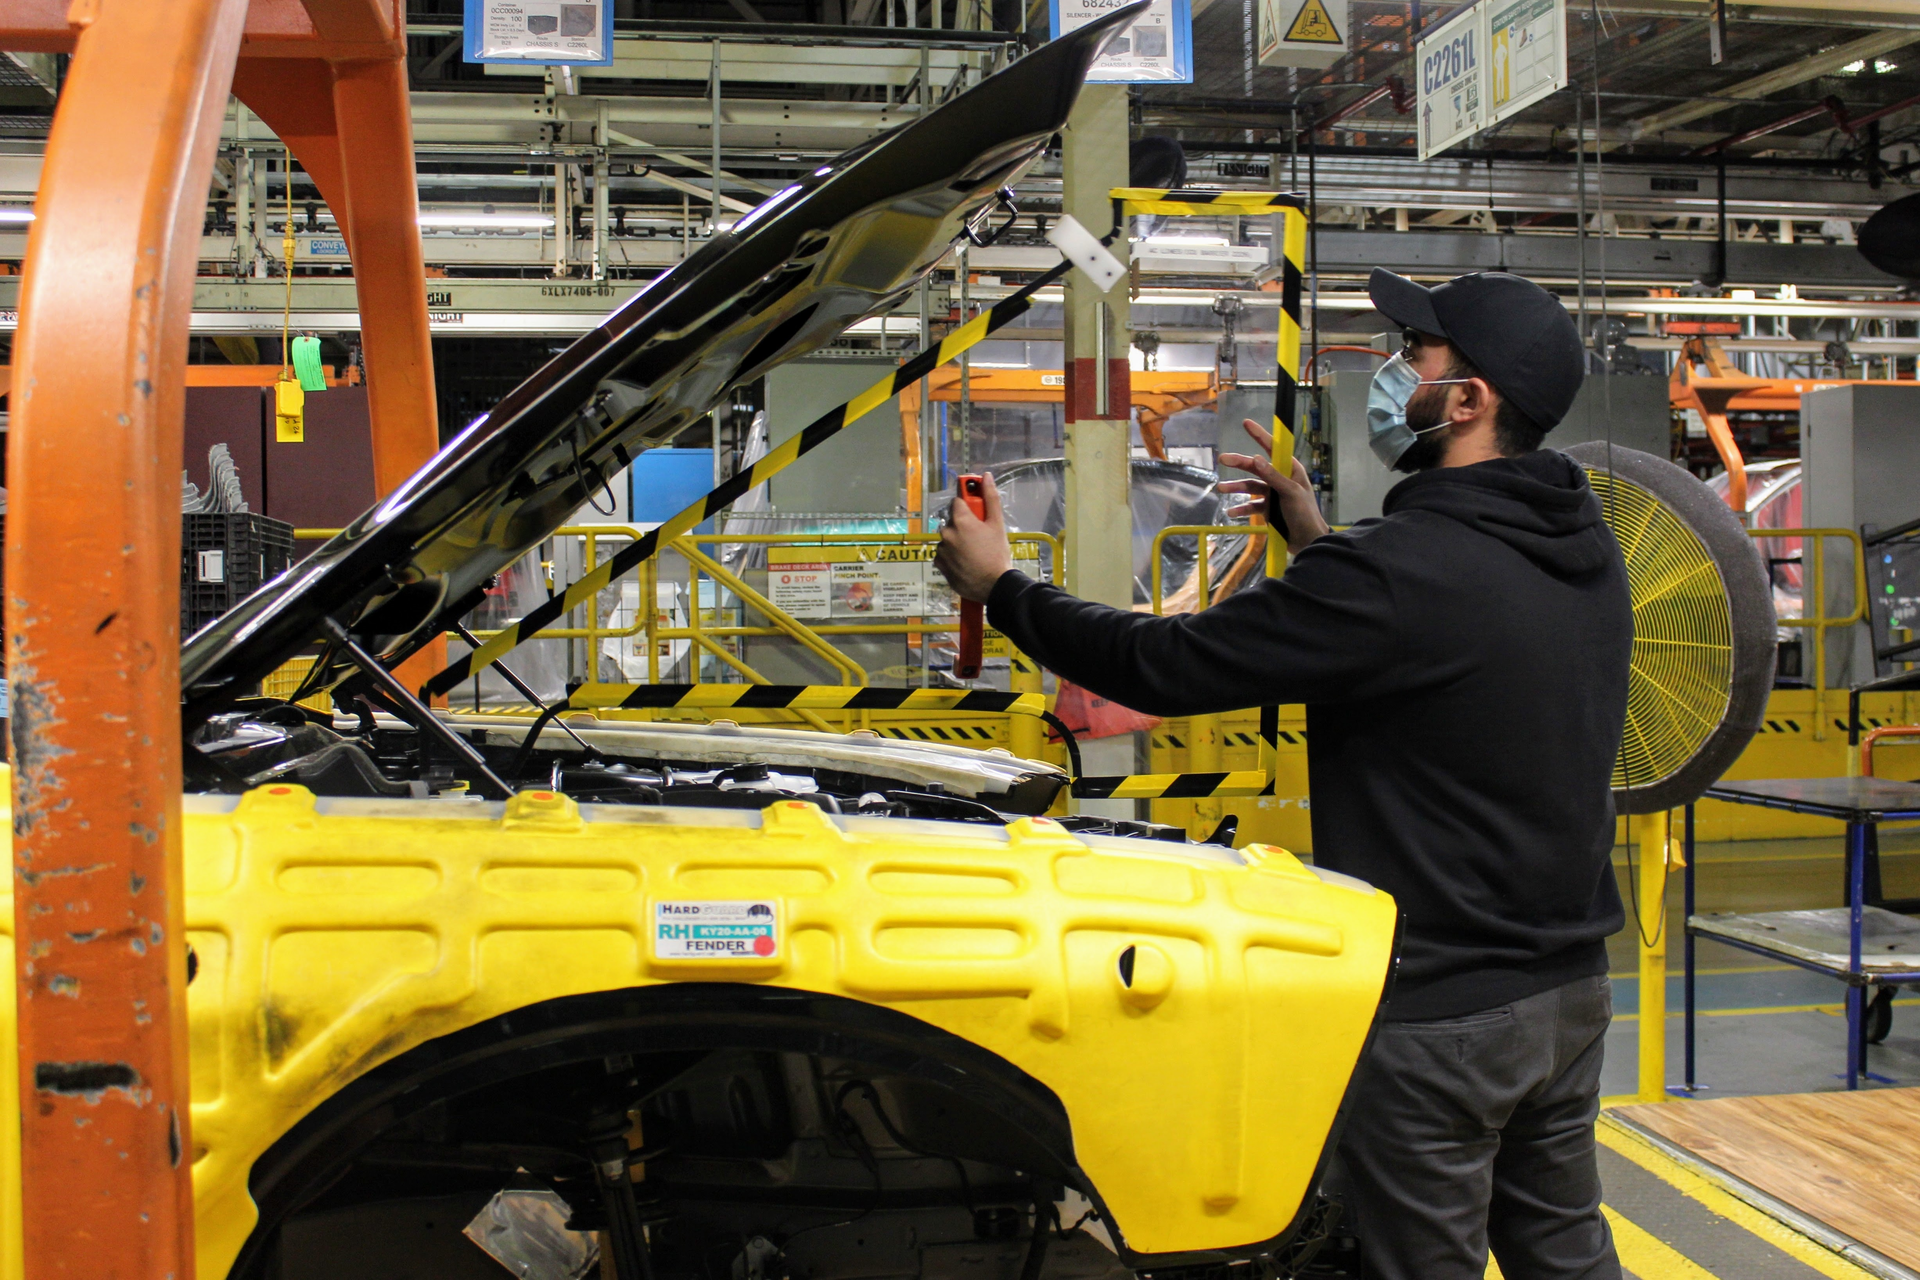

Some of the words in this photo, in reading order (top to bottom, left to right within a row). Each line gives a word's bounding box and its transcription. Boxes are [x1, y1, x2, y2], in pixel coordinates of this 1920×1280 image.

[1082, 0, 1128, 8] 68243
[1424, 28, 1476, 95] C2261L
[312, 241, 347, 250] CONVEYO
[427, 292, 449, 303] GHT
[876, 549, 938, 561] CAUTIO
[658, 924, 690, 939] RH
[686, 941, 746, 951] FENDER
